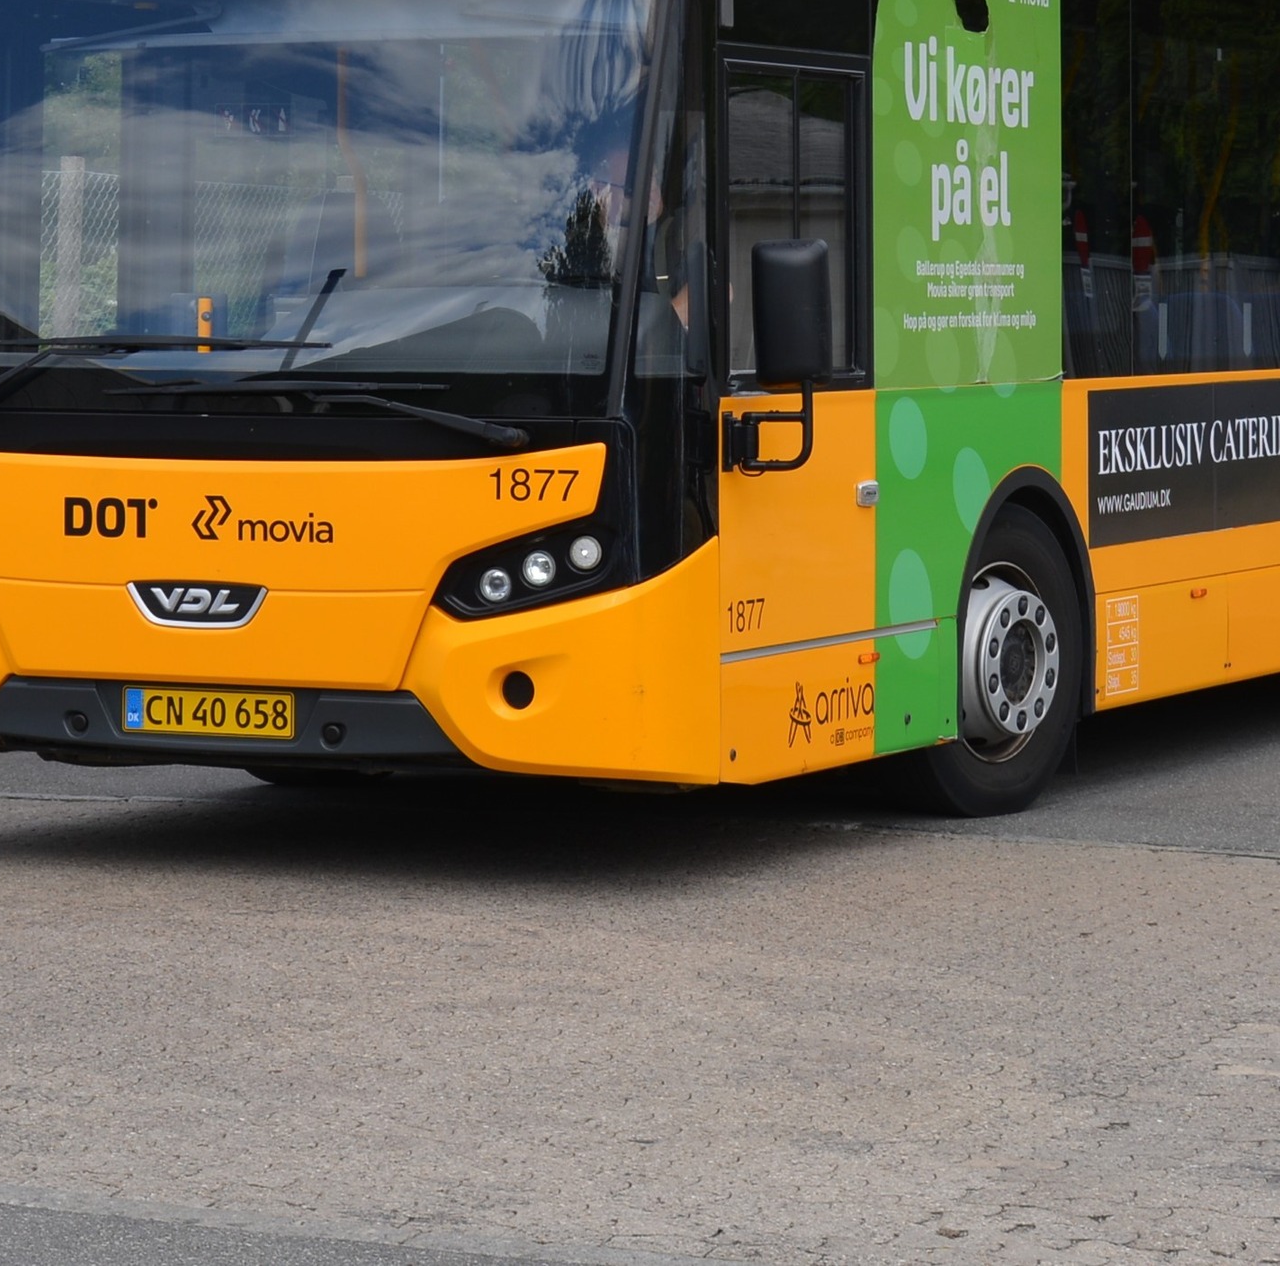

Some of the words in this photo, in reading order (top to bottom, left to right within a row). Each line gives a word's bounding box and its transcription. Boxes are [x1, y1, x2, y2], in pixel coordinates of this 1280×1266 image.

[904, 35, 938, 121] Vi
[946, 45, 1034, 128] kører
[931, 139, 971, 241] på
[980, 150, 1011, 227] el
[916, 260, 944, 278] Ballerup
[945, 263, 954, 278] og
[955, 260, 981, 279] Egedals
[981, 260, 1016, 276] kommuner
[1016, 263, 1024, 279] og
[927, 280, 947, 298] Movia
[983, 282, 1014, 300] transport
[904, 313, 917, 332] Hop
[918, 311, 927, 332] på
[928, 315, 936, 331] og
[949, 315, 957, 328] en
[958, 311, 982, 327] forskel
[982, 311, 993, 327] for
[1011, 314, 1019, 330] og
[1020, 310, 1036, 329] miljø
[1098, 422, 1206, 475] EKSKLUSIV
[489, 469, 580, 502] 1877
[1098, 488, 1171, 515] WWW.GAUDIUM.DK
[65, 497, 158, 538] DOT
[238, 512, 334, 543] movia
[151, 587, 240, 614] VDL
[727, 598, 765, 633] 1877
[146, 695, 183, 726] CN
[192, 697, 226, 727] 40
[235, 698, 288, 730] 658
[815, 676, 874, 725] arriva
[127, 713, 139, 722] DK
